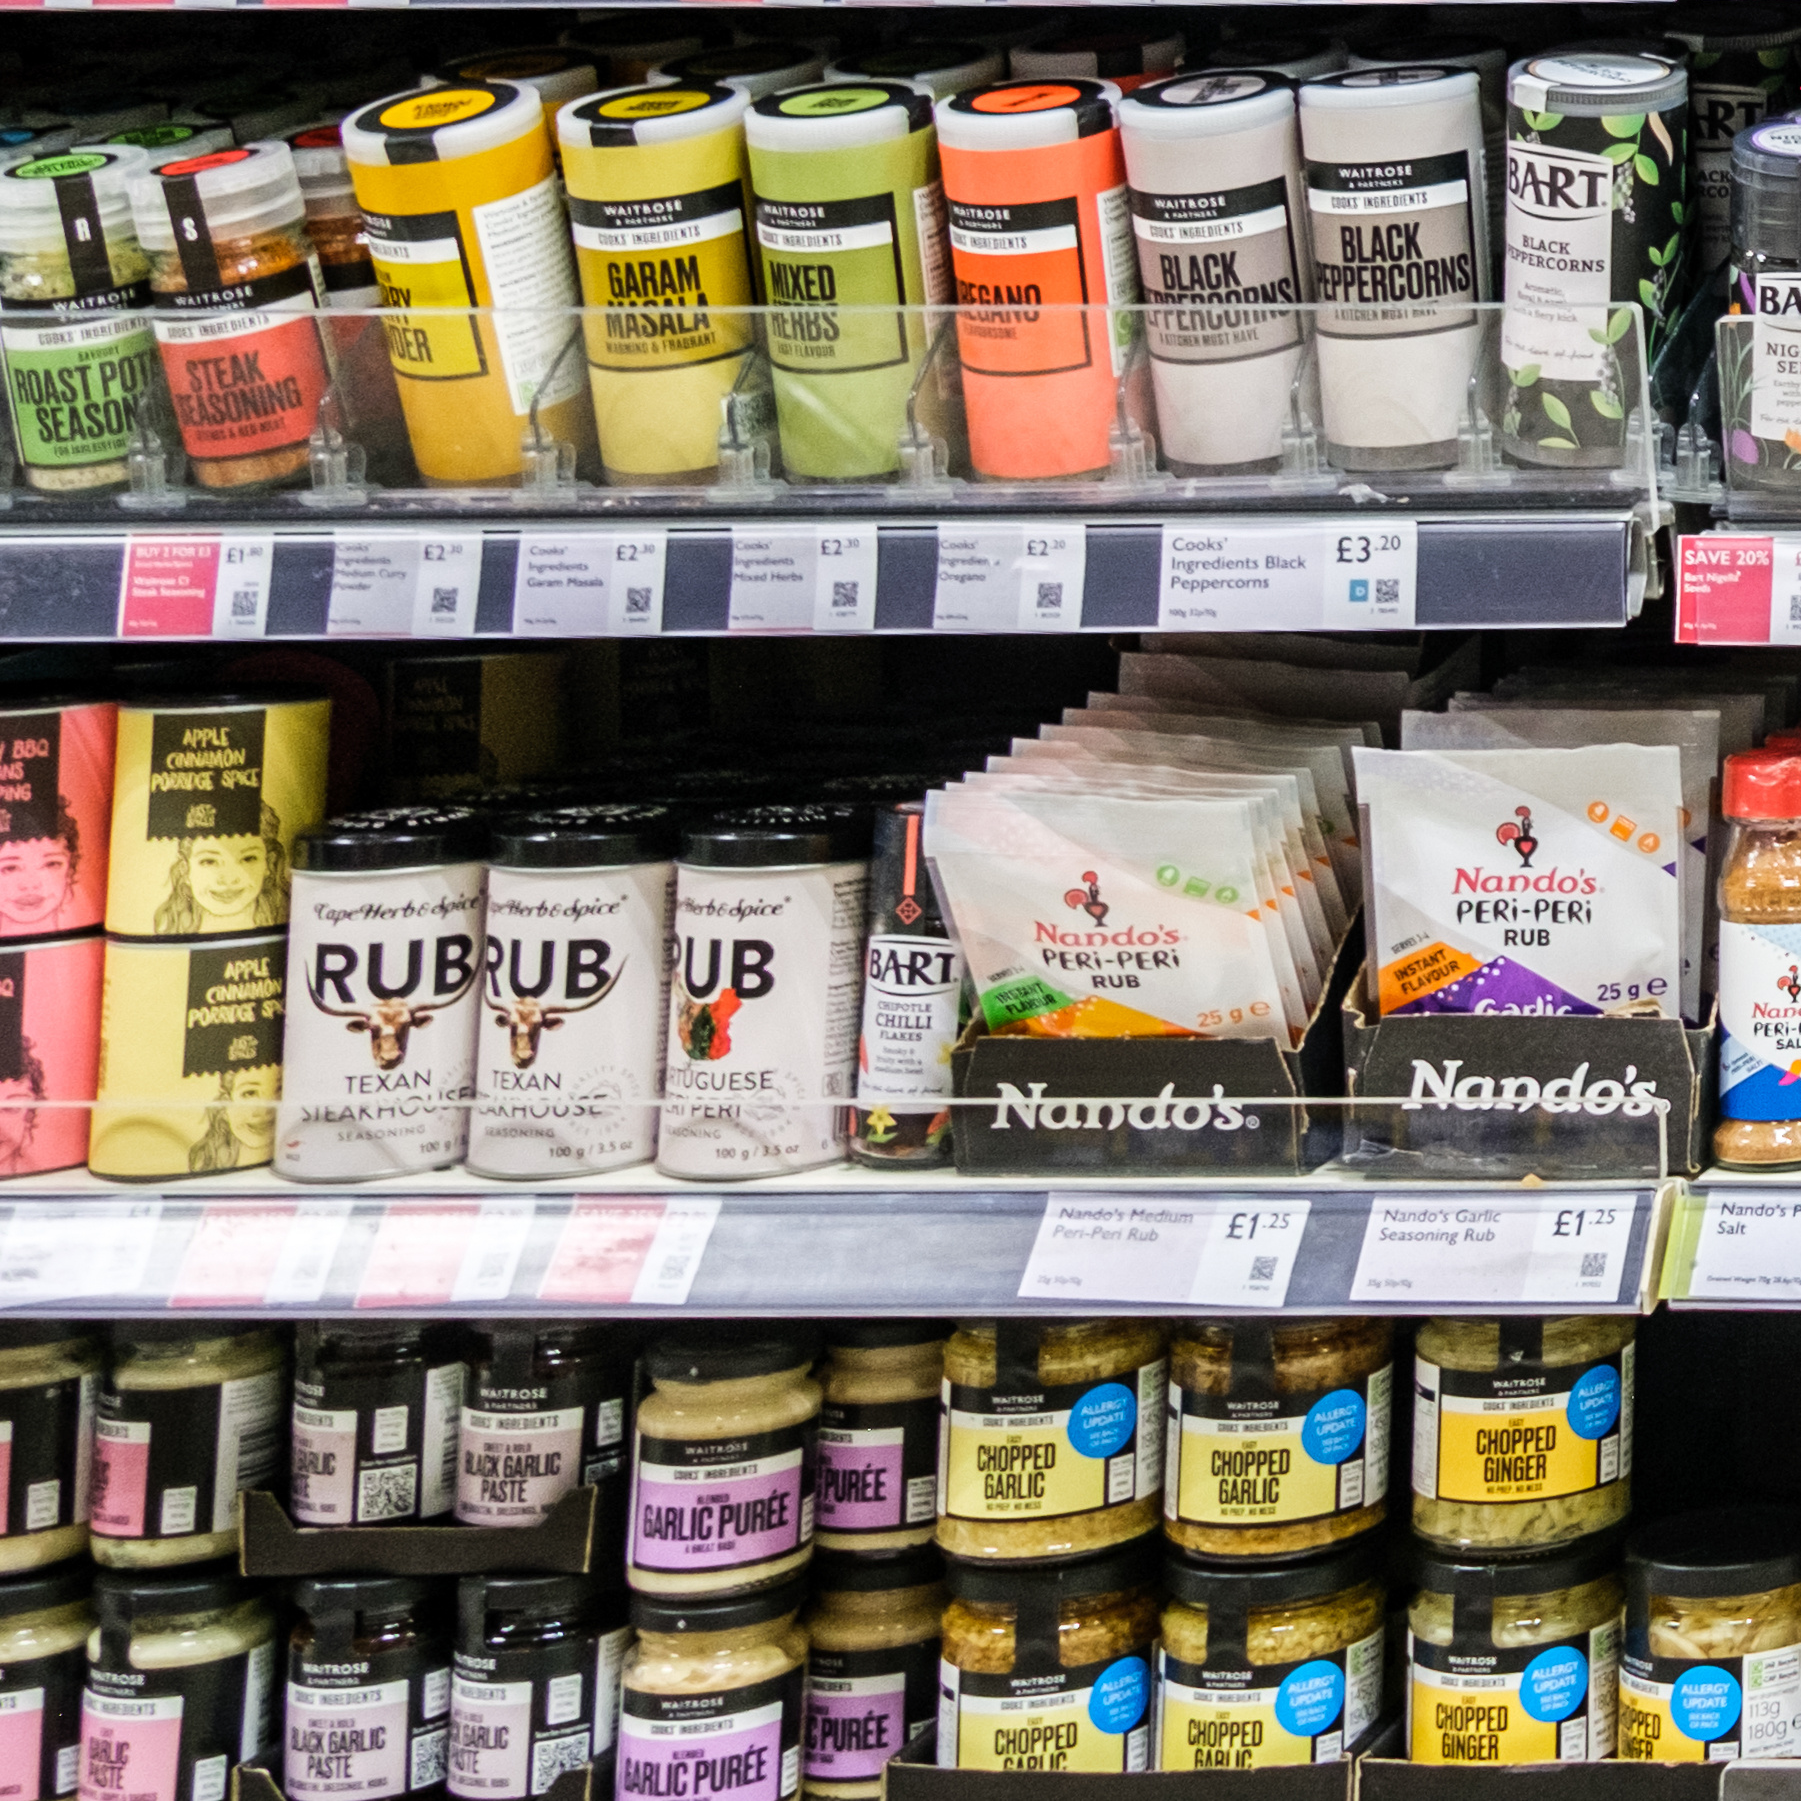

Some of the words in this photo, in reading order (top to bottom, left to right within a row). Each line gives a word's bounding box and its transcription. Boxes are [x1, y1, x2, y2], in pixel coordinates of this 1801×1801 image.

[1523, 236, 1569, 253] BLACK
[609, 256, 699, 298] GARAM
[1453, 868, 1597, 896] Nando's
[1505, 929, 1550, 947] RUB
[314, 936, 473, 1000] RUB
[345, 1071, 430, 1094] TEXAN
[992, 1083, 1244, 1131] Nando's
[1721, 1202, 1785, 1218] Nando's
[1717, 1221, 1747, 1235] Salt
[977, 1443, 1055, 1470] CHOPPED
[1485, 1453, 1546, 1483] GINGER
[984, 1470, 1045, 1499] GARLIC
[644, 1498, 711, 1541] GARLIC
[717, 1491, 790, 1536] PURÉE
